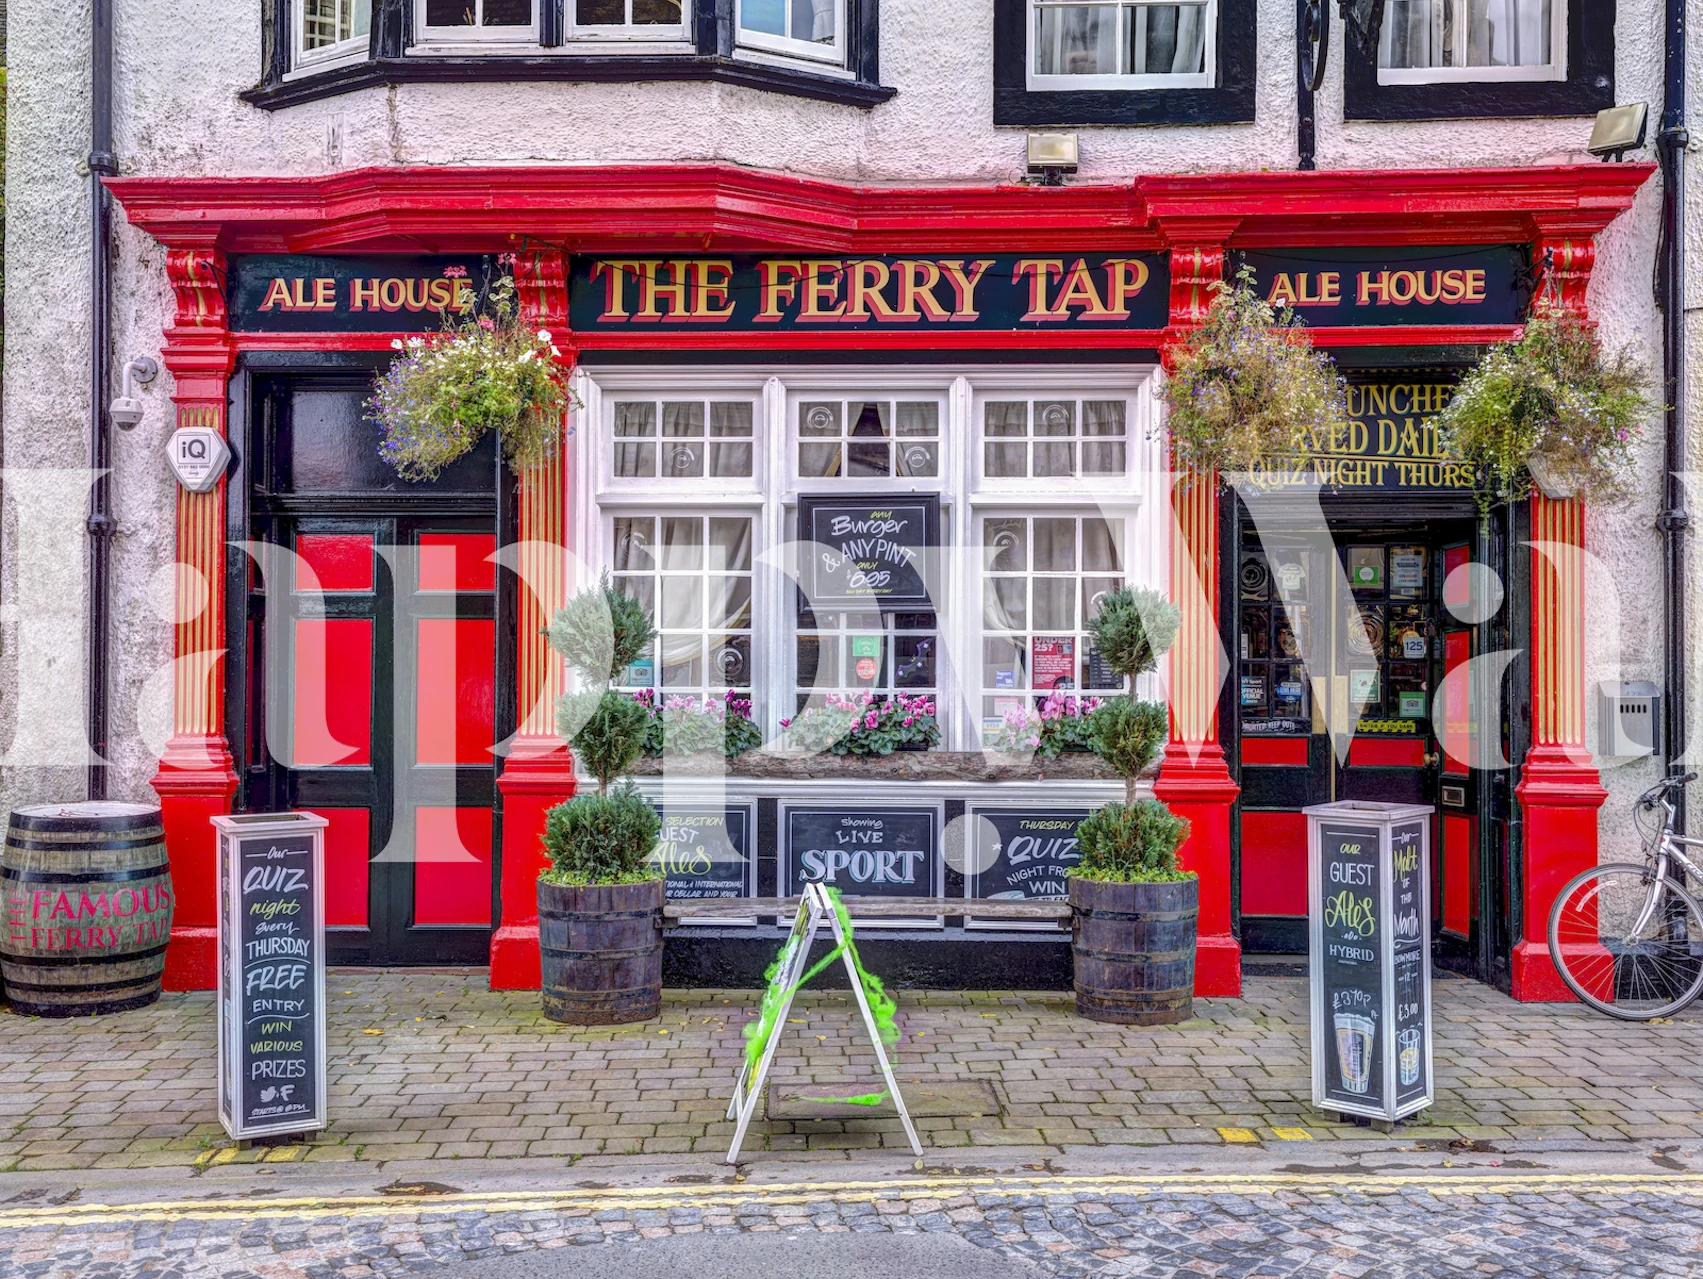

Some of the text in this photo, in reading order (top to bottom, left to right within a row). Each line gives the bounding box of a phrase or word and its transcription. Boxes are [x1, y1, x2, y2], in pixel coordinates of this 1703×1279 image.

[258, 277, 474, 312] ALE HOUSE
[588, 257, 1151, 323] THE FERRY TAP
[1267, 268, 1487, 306] ALE HOUSE
[1347, 383, 1456, 417] UNCHE
[181, 438, 206, 459] iQ
[1249, 456, 1477, 492] QUIZ NIGHT THURS
[830, 515, 909, 538] Burger
[821, 538, 917, 573] & ANY PINT
[1033, 636, 1073, 645] UNDER
[1034, 643, 1054, 652] 25?
[1405, 641, 1423, 651] 125
[664, 815, 725, 827] SELECTION
[1019, 820, 1075, 831] THURSDAY
[658, 826, 700, 844] UEST
[835, 830, 884, 844] LIVE
[267, 846, 288, 860] Our
[1007, 835, 1080, 866] QUIZ
[798, 849, 925, 884] SPORT
[1006, 864, 1072, 886] NIGHT FRO
[1329, 861, 1375, 886] GUEST
[242, 864, 309, 895] QUIZ
[1028, 880, 1066, 895] WIN
[31, 881, 171, 920] FAMOUS
[673, 889, 702, 898] CELLAR
[703, 889, 720, 898] AND
[249, 898, 302, 920] night
[1325, 889, 1377, 937] Ales
[30, 917, 169, 950] FERRY TAP
[245, 936, 311, 960] THURSDAY
[1329, 944, 1375, 962] HYBRID
[245, 964, 307, 997] FREE
[252, 999, 305, 1013] ENTRY
[261, 1020, 293, 1035] WIN
[250, 1040, 303, 1055] VARIOUS
[252, 1059, 307, 1081] PRIZES
